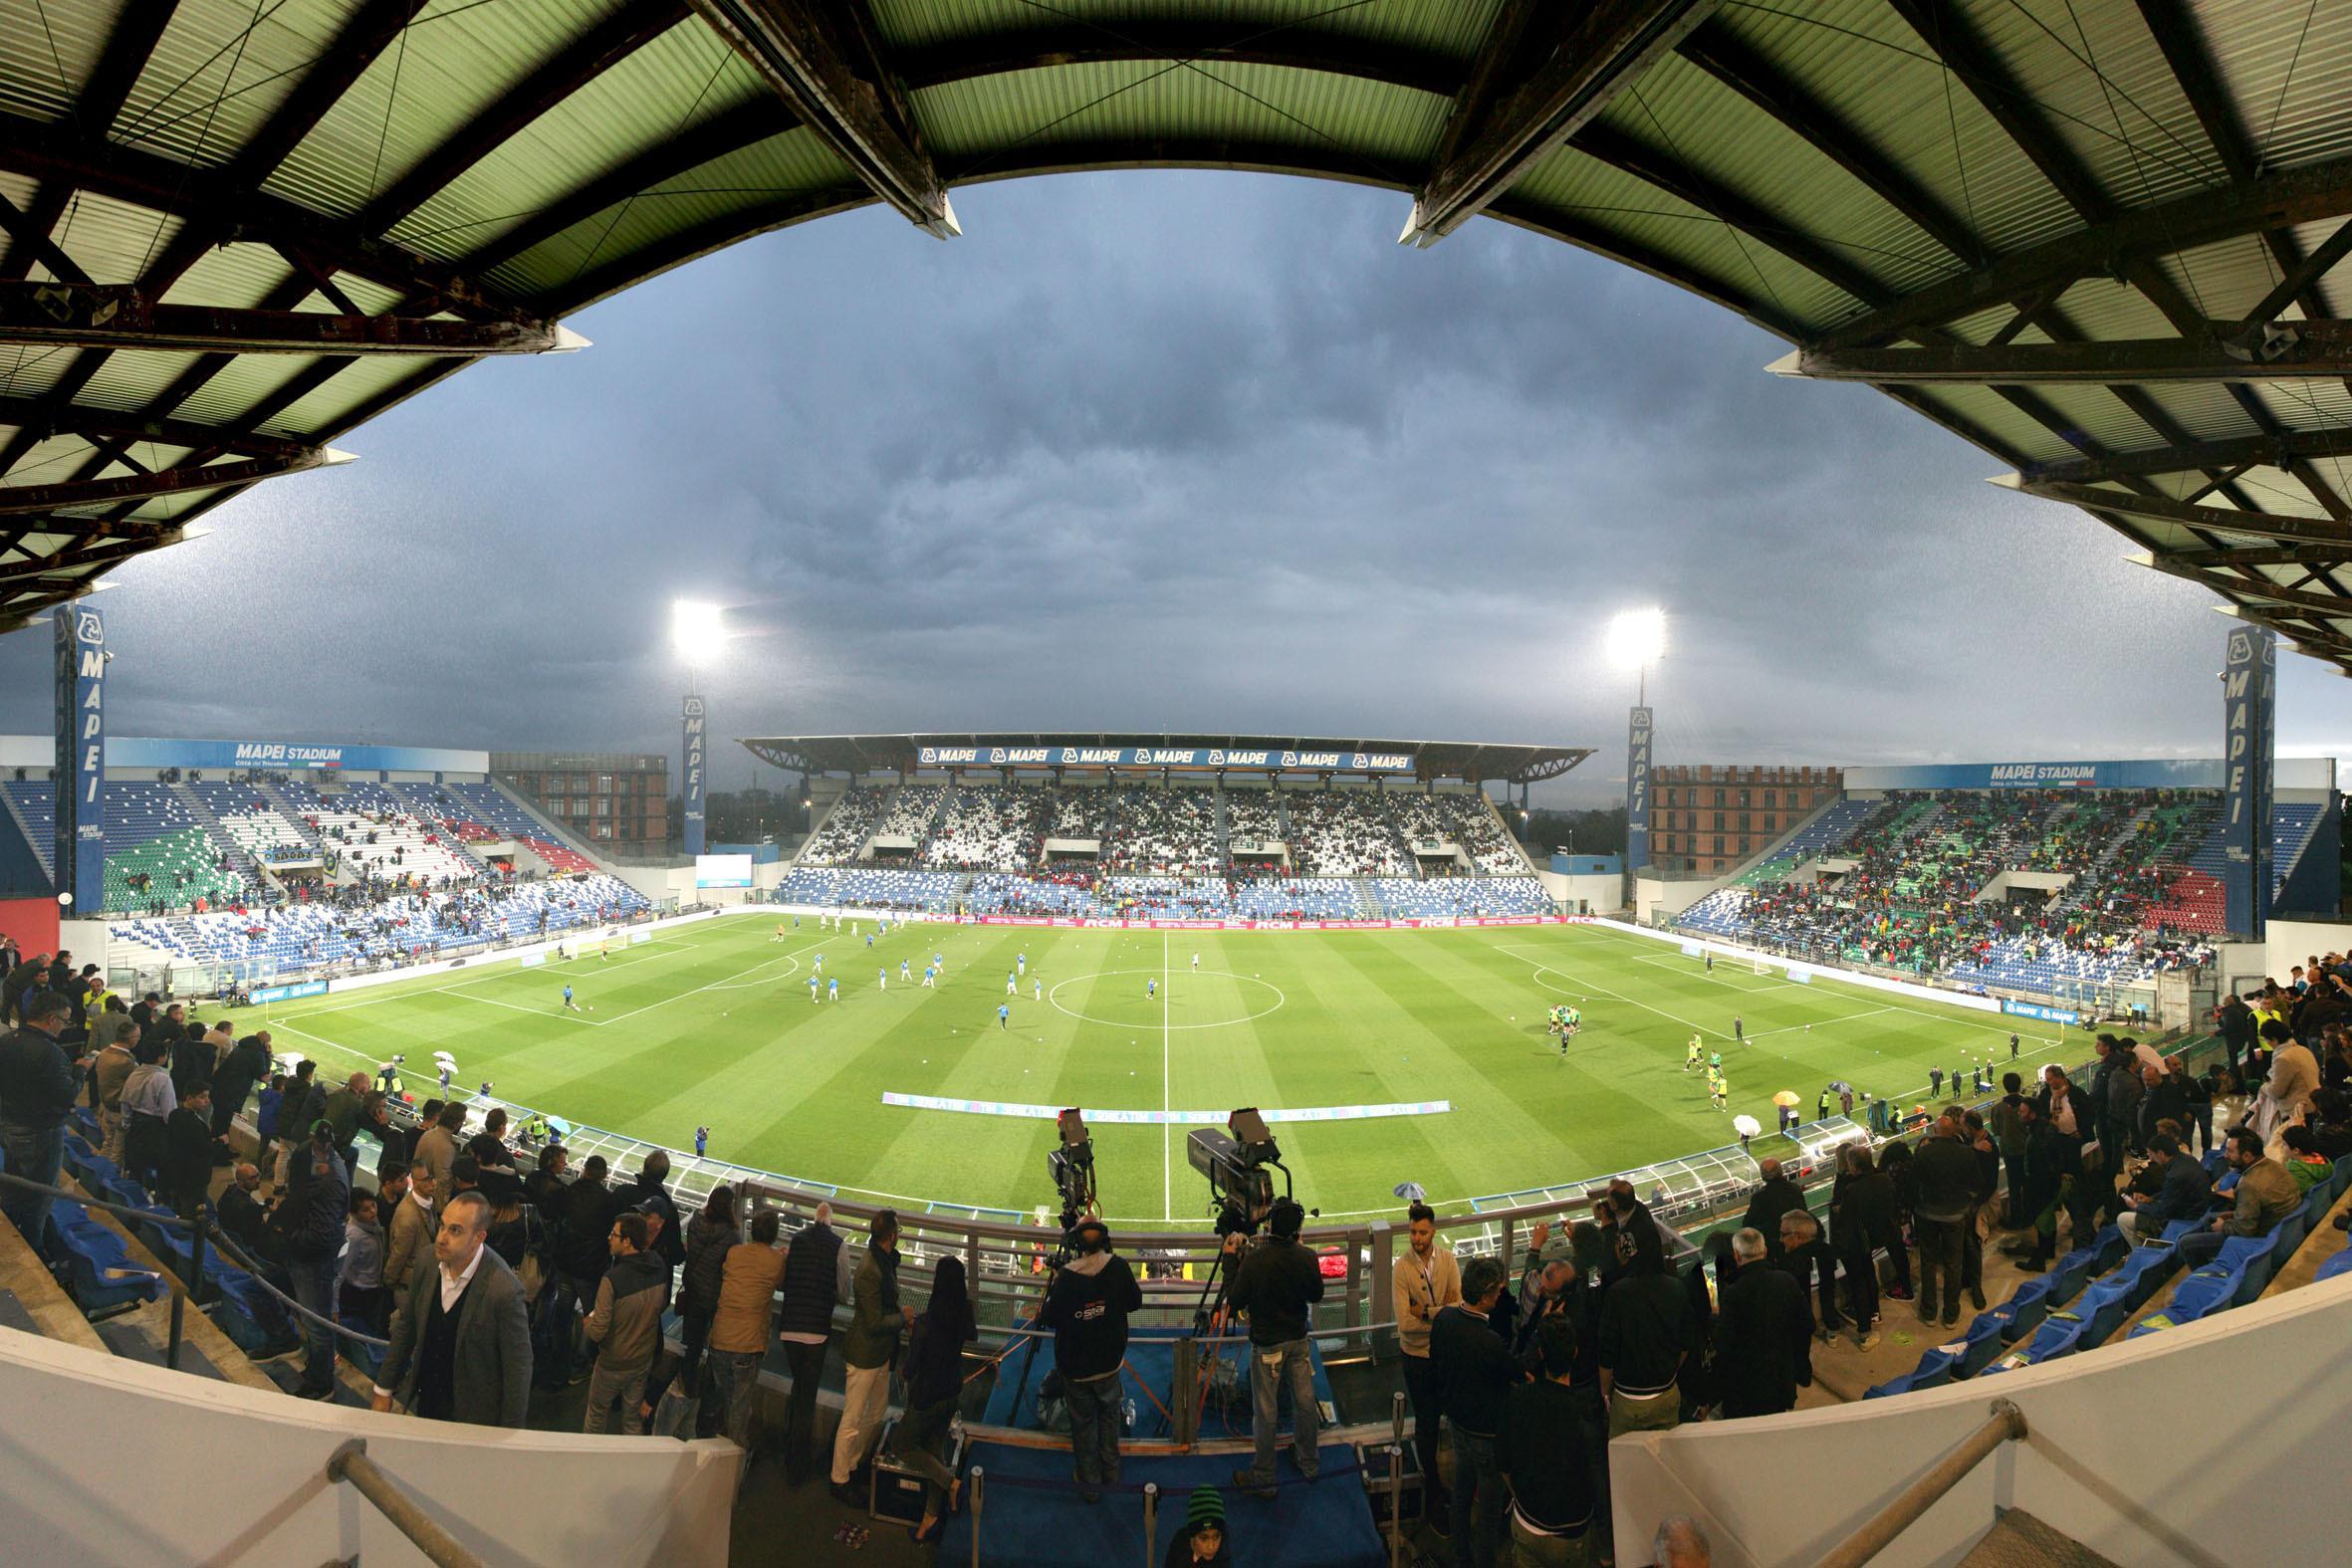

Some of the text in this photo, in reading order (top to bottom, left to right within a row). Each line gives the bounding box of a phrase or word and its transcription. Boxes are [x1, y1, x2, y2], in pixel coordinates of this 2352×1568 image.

[81, 650, 104, 803] MAPEI
[236, 744, 342, 760] MAPEI STADIUM
[2226, 669, 2250, 824] MAPEI
[686, 718, 702, 800] MAPEI
[938, 750, 977, 762] MAPEI
[1008, 749, 1048, 762] MAPEI
[1080, 750, 1121, 763] MAPEI
[1154, 751, 1195, 764] MAPEI
[1227, 752, 1268, 765] MAPEI
[1298, 753, 1339, 767] MAPEI
[1370, 755, 1410, 769] MAPEI
[1632, 730, 1649, 812] MAPEI
[1992, 765, 2096, 780] MAPEI STADIUM
[1419, 919, 1455, 928] RCM
[2015, 1006, 2037, 1015] MAPEI
[2052, 1011, 2074, 1021] MAPEI
